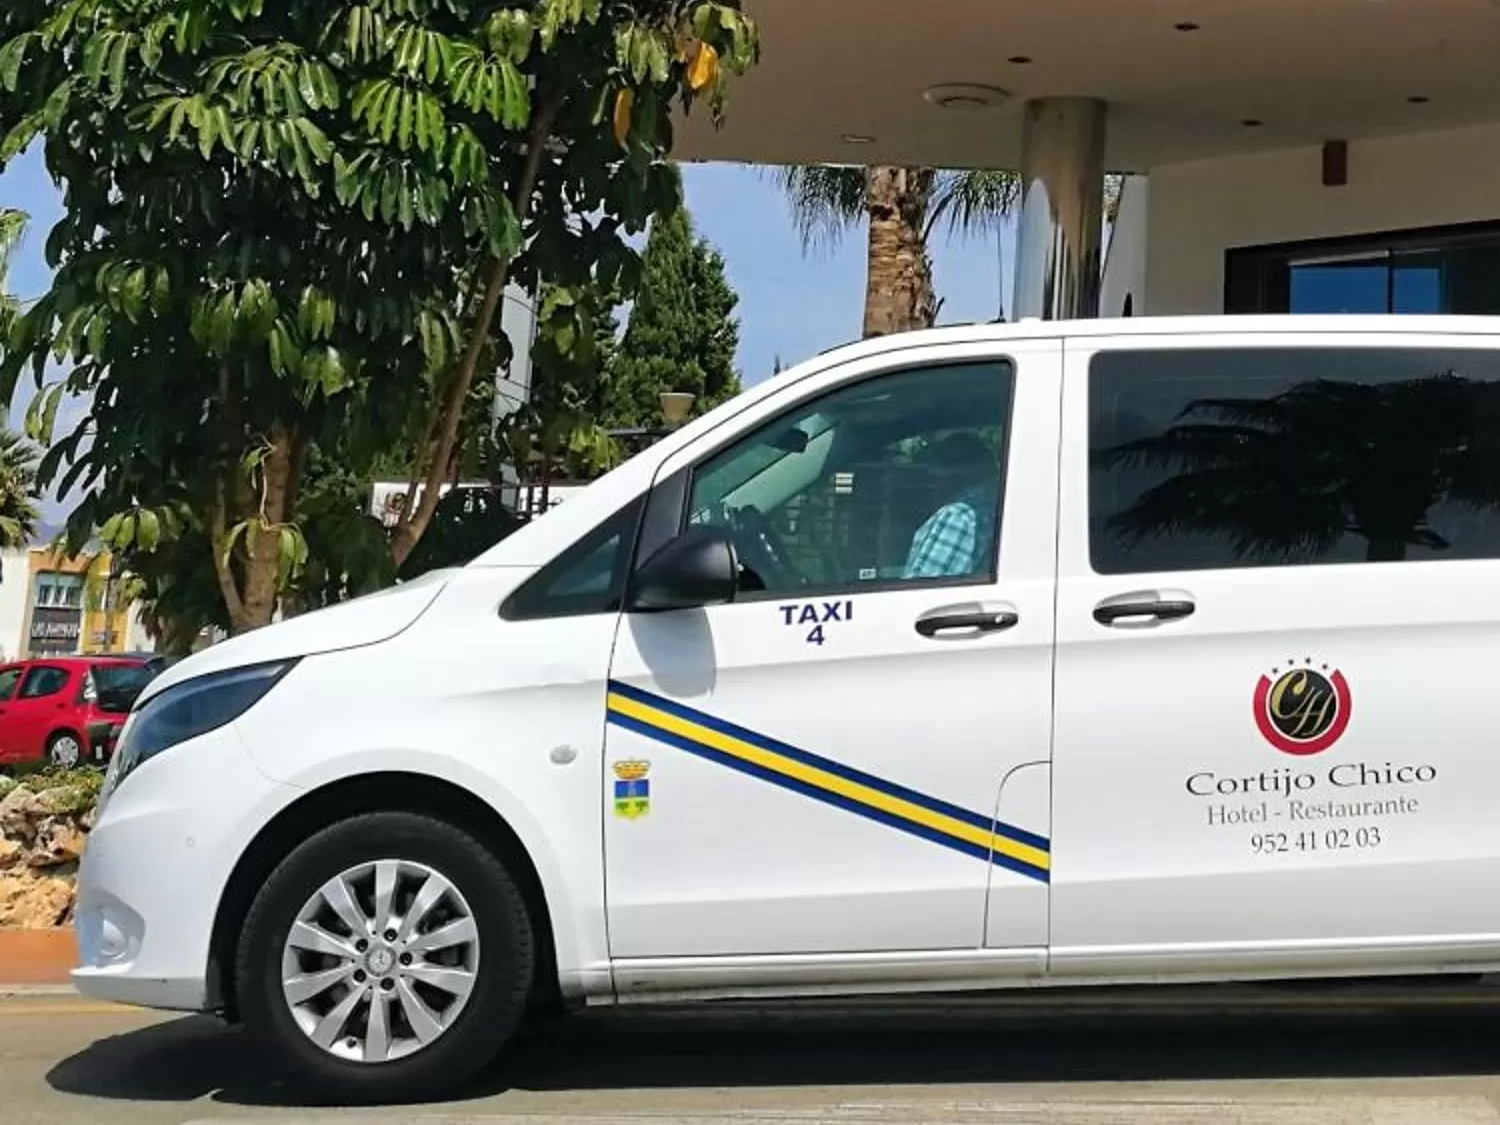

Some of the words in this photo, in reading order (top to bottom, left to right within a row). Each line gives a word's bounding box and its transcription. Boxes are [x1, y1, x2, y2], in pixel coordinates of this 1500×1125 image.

[779, 600, 853, 625] TAXI
[806, 624, 825, 646] 4
[1185, 768, 1316, 797] Cortijo
[1328, 762, 1438, 788] Chico
[1207, 802, 1268, 826] Hotel
[1289, 796, 1419, 822] Restaurante
[1250, 832, 1289, 854] 952
[1295, 831, 1317, 851] 41
[1325, 828, 1351, 850] 02
[1355, 826, 1382, 847] 03
